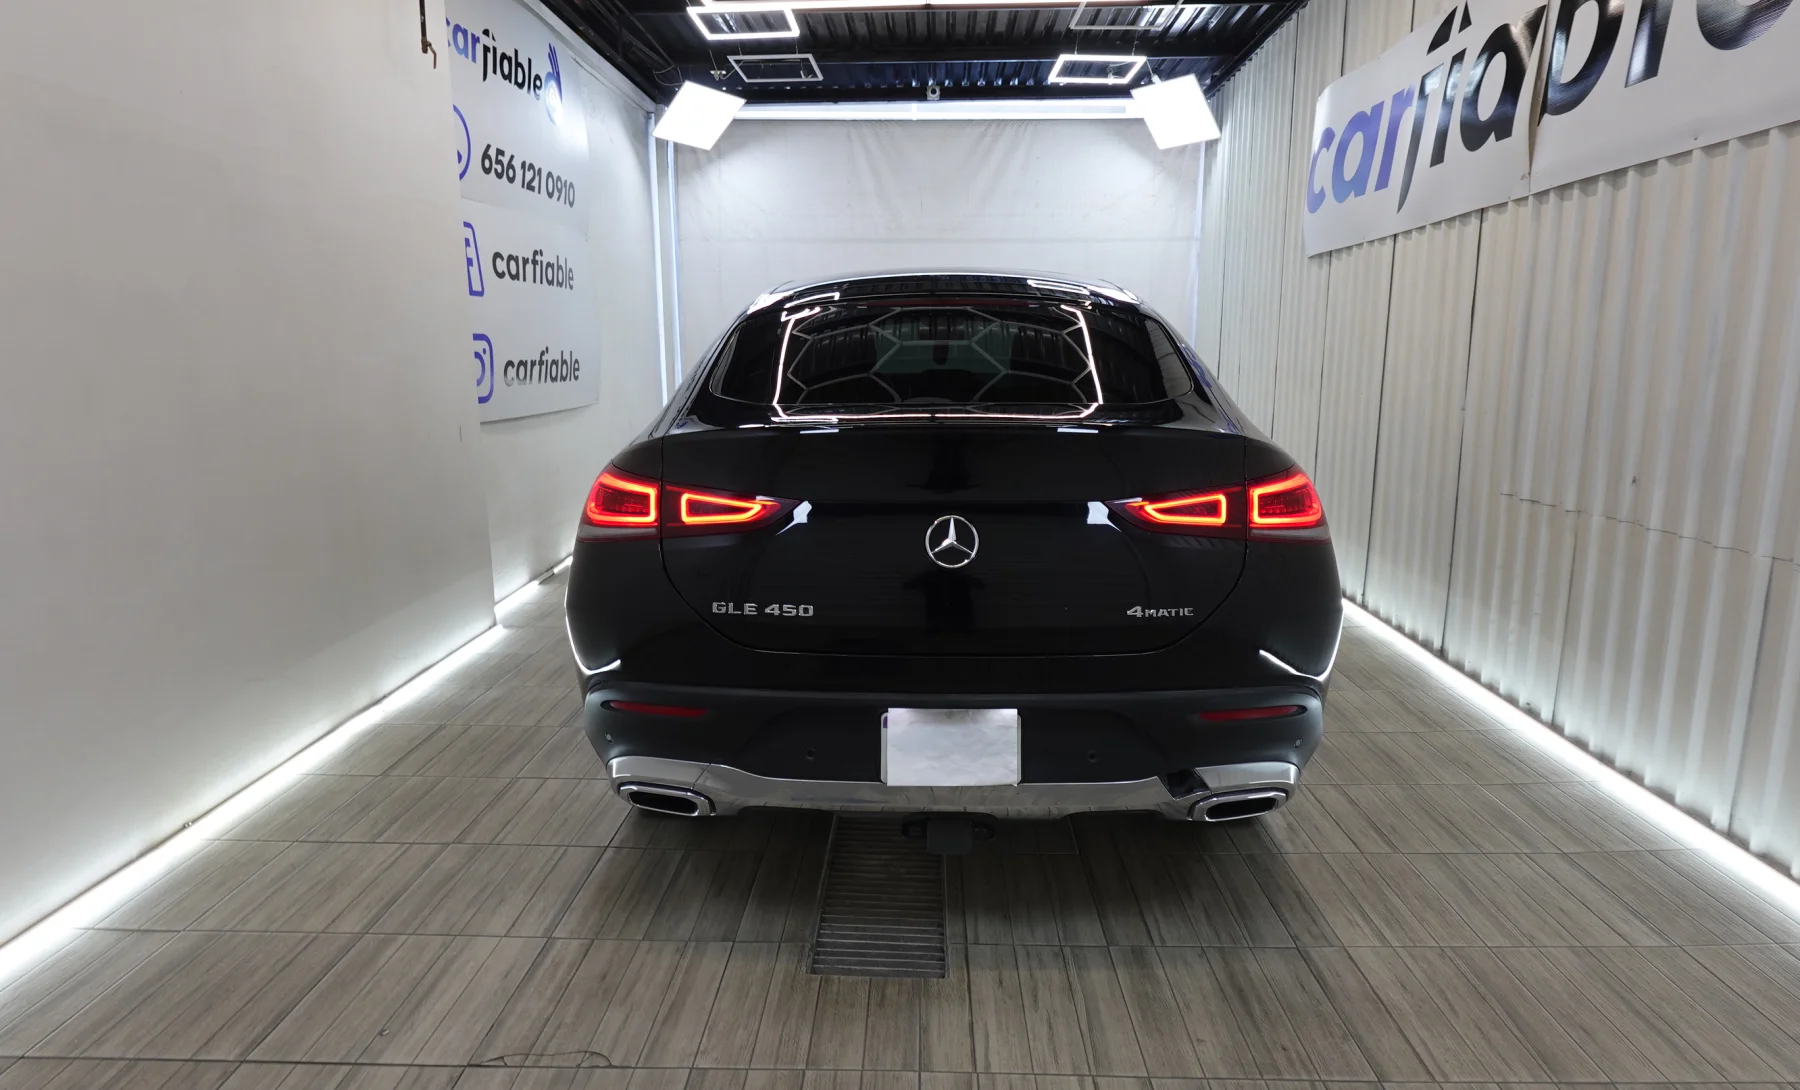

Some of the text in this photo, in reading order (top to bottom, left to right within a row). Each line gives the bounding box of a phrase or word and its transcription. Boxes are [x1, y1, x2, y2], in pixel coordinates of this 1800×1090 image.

[446, 17, 543, 101] arfiable
[1307, 0, 1793, 214] carfiab
[481, 143, 575, 208] 656 121 0910
[492, 249, 574, 290] carfiable
[503, 346, 580, 387] carfiable
[712, 602, 814, 617] GLE 450
[1126, 605, 1194, 618] 4MATIC
